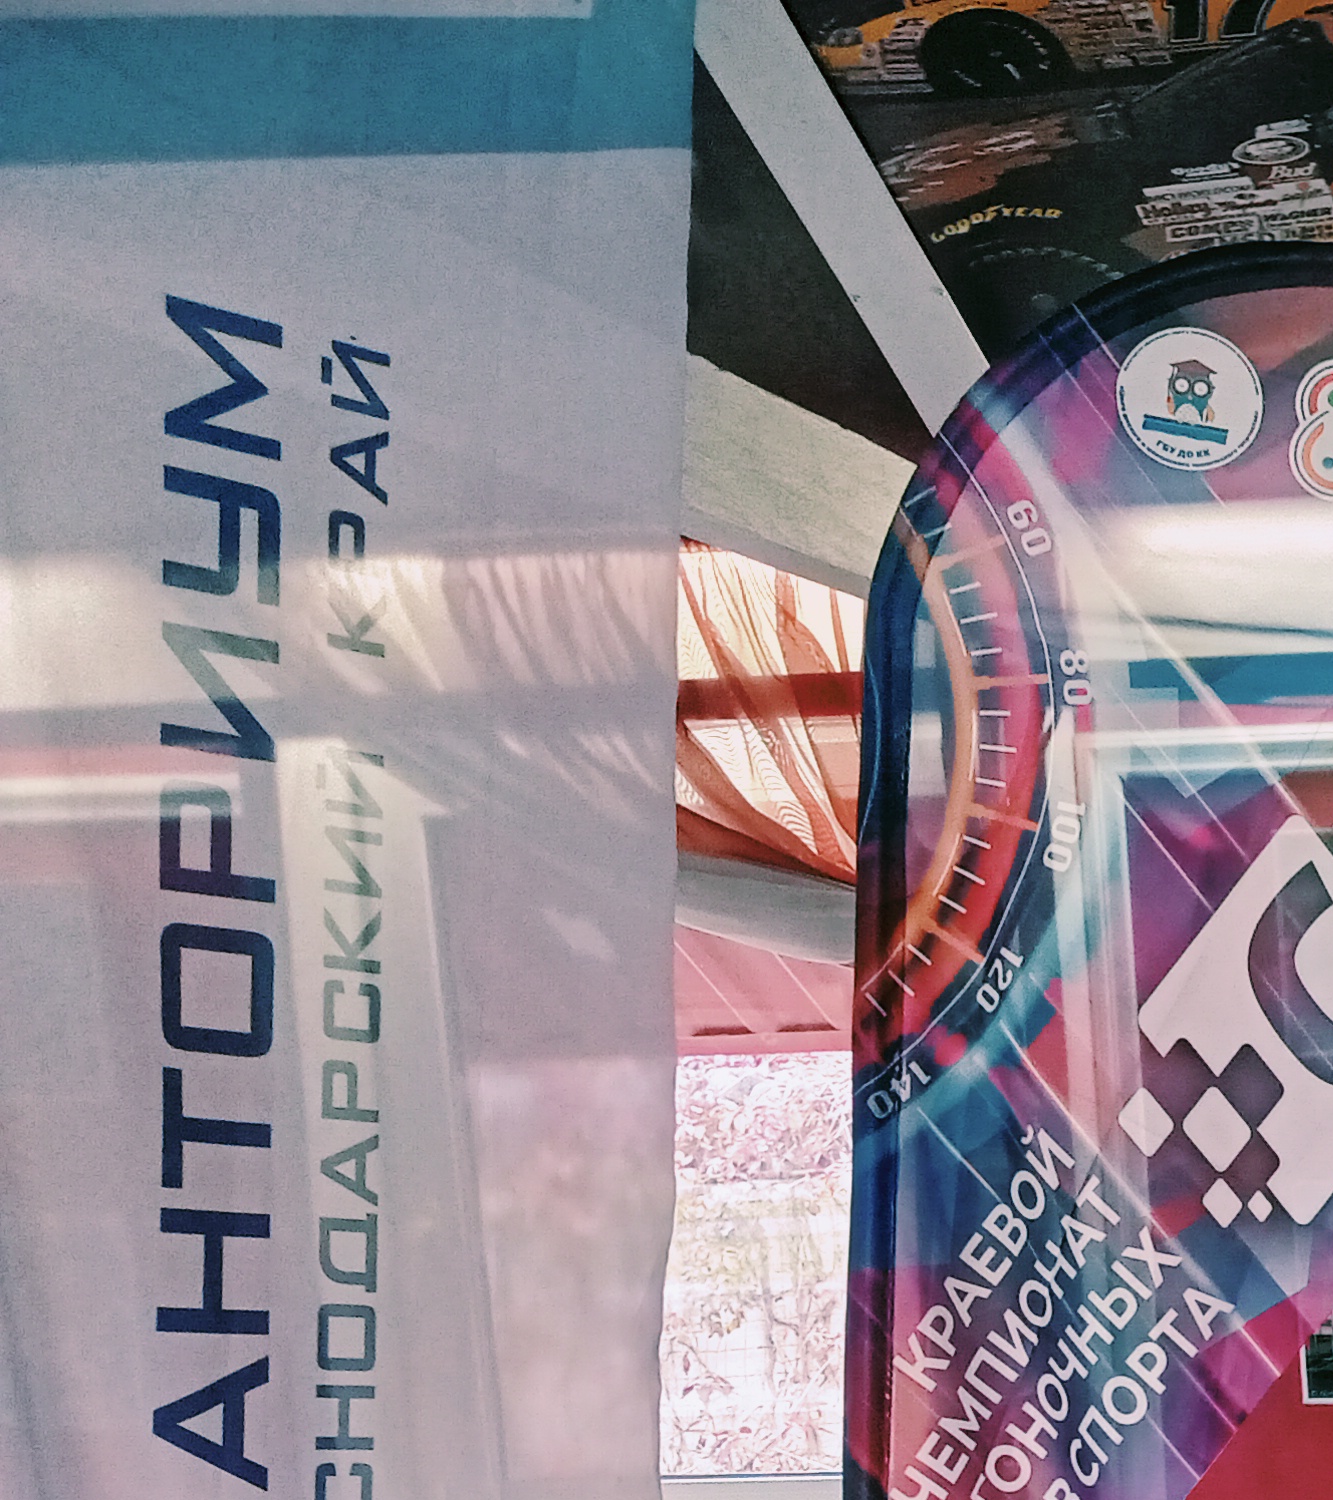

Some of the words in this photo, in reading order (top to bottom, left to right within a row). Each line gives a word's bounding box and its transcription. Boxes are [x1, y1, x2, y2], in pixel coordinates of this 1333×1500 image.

[1269, 162, 1317, 181] Bud
[930, 203, 1063, 244] GOODYEAR
[322, 338, 391, 658] КРАЙ
[1006, 499, 1053, 558] 60
[1059, 648, 1094, 706] 80
[1042, 802, 1087, 875] 100
[976, 945, 1024, 1014] 120
[865, 1060, 931, 1121] 140
[892, 1125, 1076, 1392] КРАЕВОЙ
[1070, 1285, 1236, 1487] СПОРТА
